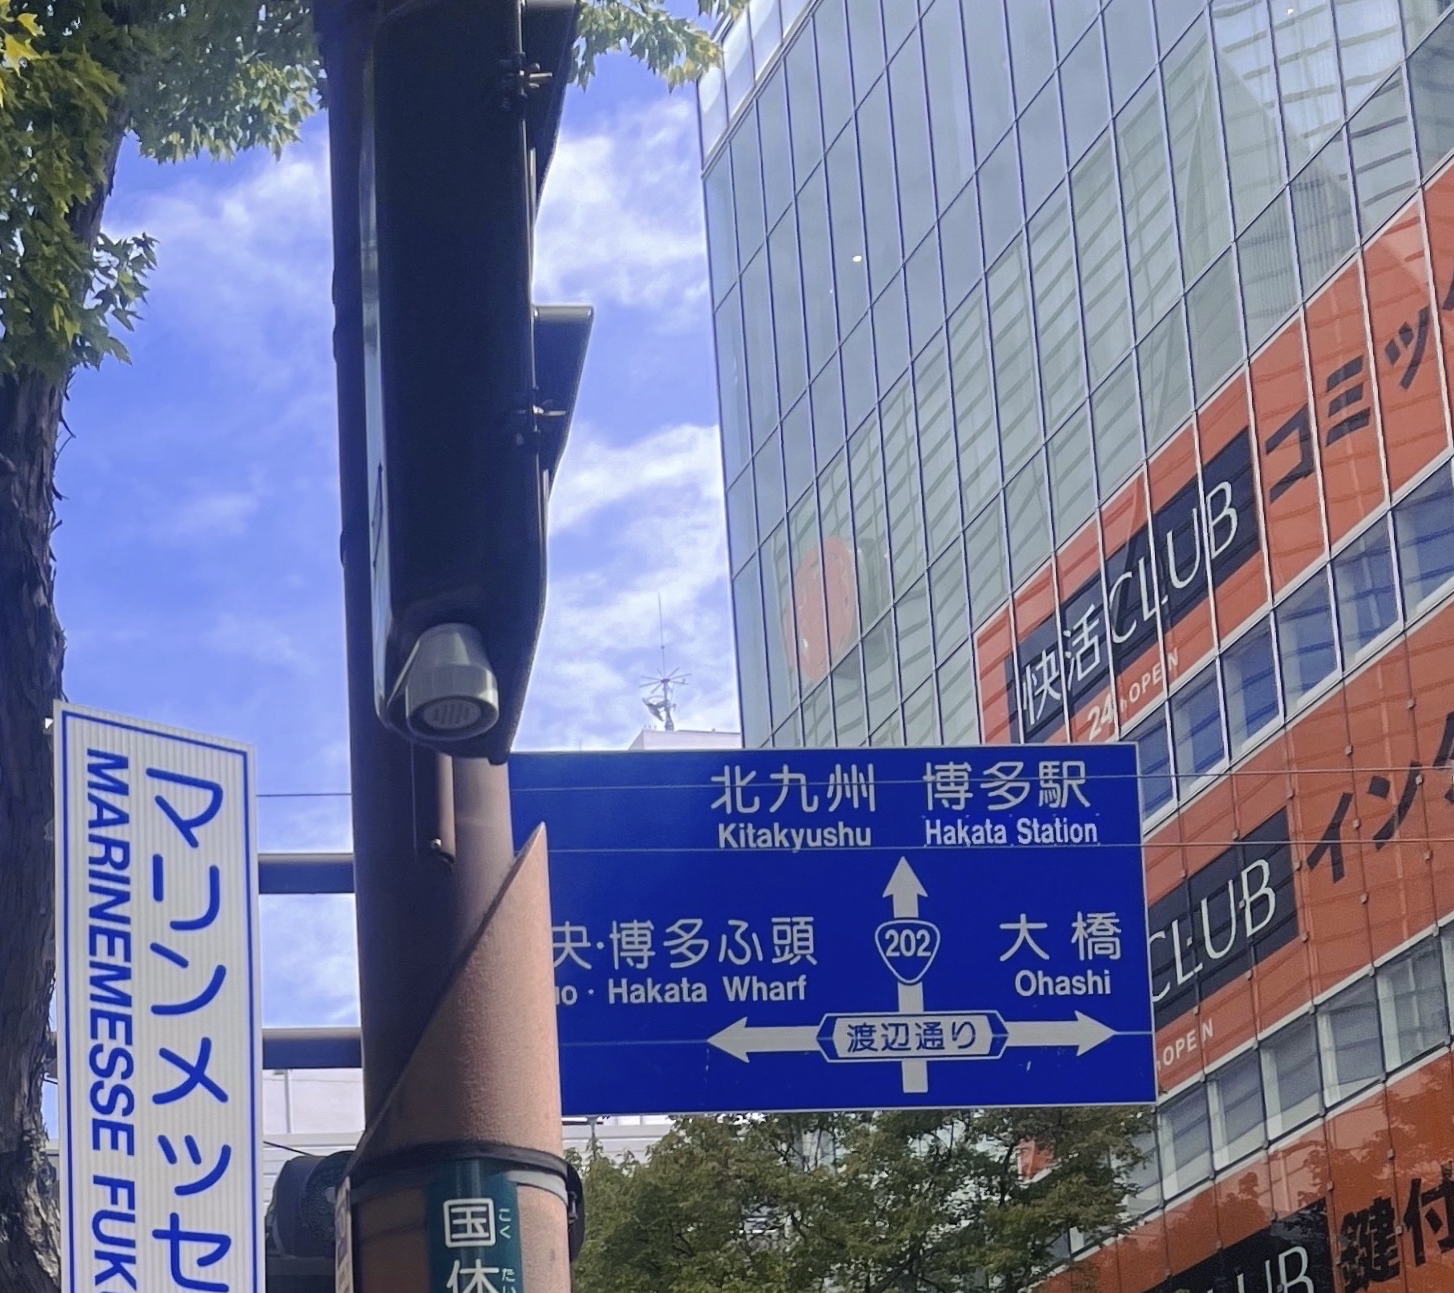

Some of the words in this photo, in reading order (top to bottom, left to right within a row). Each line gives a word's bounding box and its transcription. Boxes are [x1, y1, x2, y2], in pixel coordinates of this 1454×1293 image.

[1022, 481, 1239, 726] 快活CLUB
[710, 763, 876, 814] 北九州
[923, 760, 1092, 811] 博多駅
[718, 821, 872, 853] Kitakyushu
[925, 818, 1008, 847] Hakata
[1016, 815, 1098, 846] Station
[85, 747, 135, 1158] MARINEMESSE
[884, 929, 932, 958] 202
[999, 910, 1122, 962] 大橋
[608, 977, 708, 1004] Hakata
[722, 974, 807, 1002] Wharf
[1014, 969, 1112, 997] Ohashi
[846, 1020, 976, 1053] 渡辺通り
